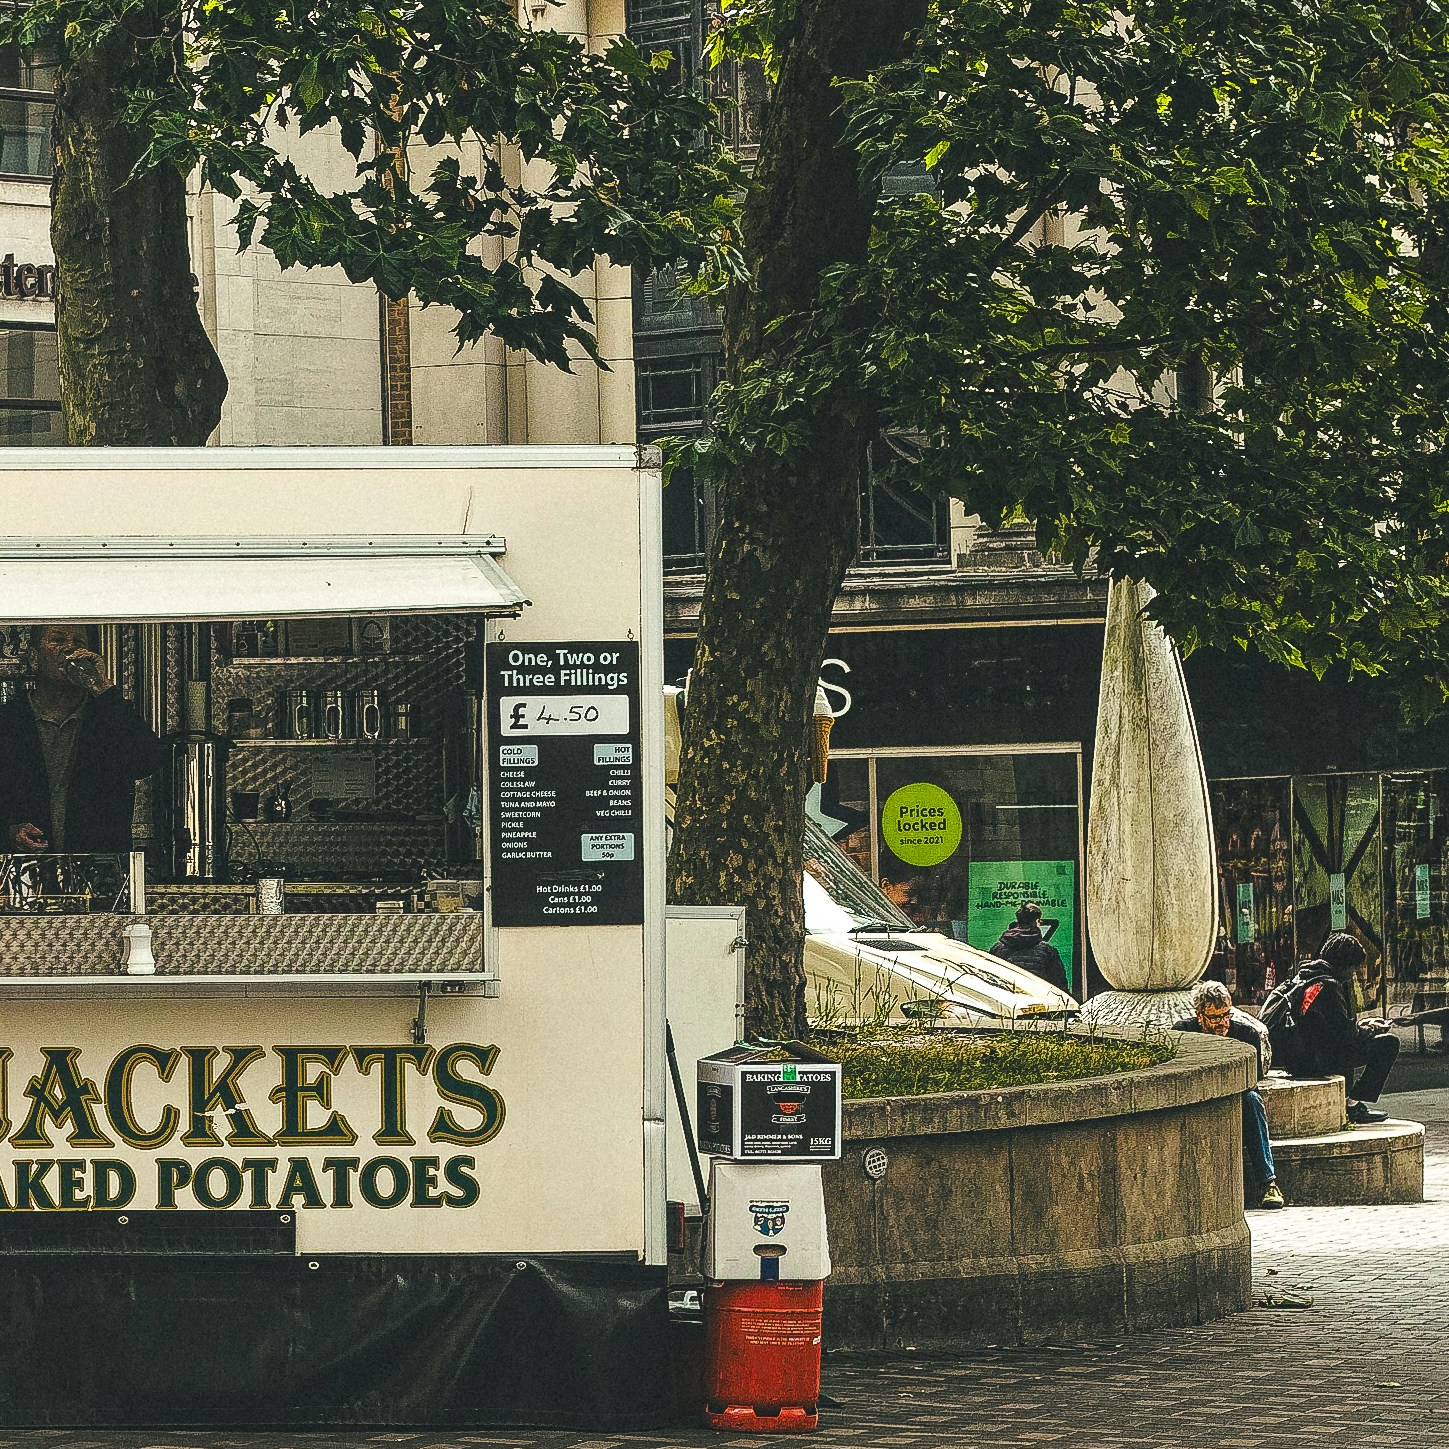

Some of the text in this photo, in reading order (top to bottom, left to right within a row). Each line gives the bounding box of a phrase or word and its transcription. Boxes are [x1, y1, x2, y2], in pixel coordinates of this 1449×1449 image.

[508, 649, 620, 668] One, Two or
[500, 669, 629, 690] Three Fillings
[502, 747, 523, 755] COLD
[614, 746, 631, 754] HOT
[502, 757, 536, 765] FILLINGS
[597, 756, 631, 764] FILLINGS
[531, 790, 557, 798] CHEESE
[899, 804, 945, 818] Prices
[897, 817, 947, 833] locked
[899, 835, 944, 846] since 2021
[601, 851, 615, 859] 50p
[536, 884, 603, 893] Hot Drinks £1.00
[548, 895, 592, 904] Cans £1.00
[542, 905, 598, 914] Cartons £1.00
[745, 1073, 832, 1082] BAKING TATOES
[809, 1137, 832, 1145] 15KG
[155, 1154, 483, 1212] POTATOES
